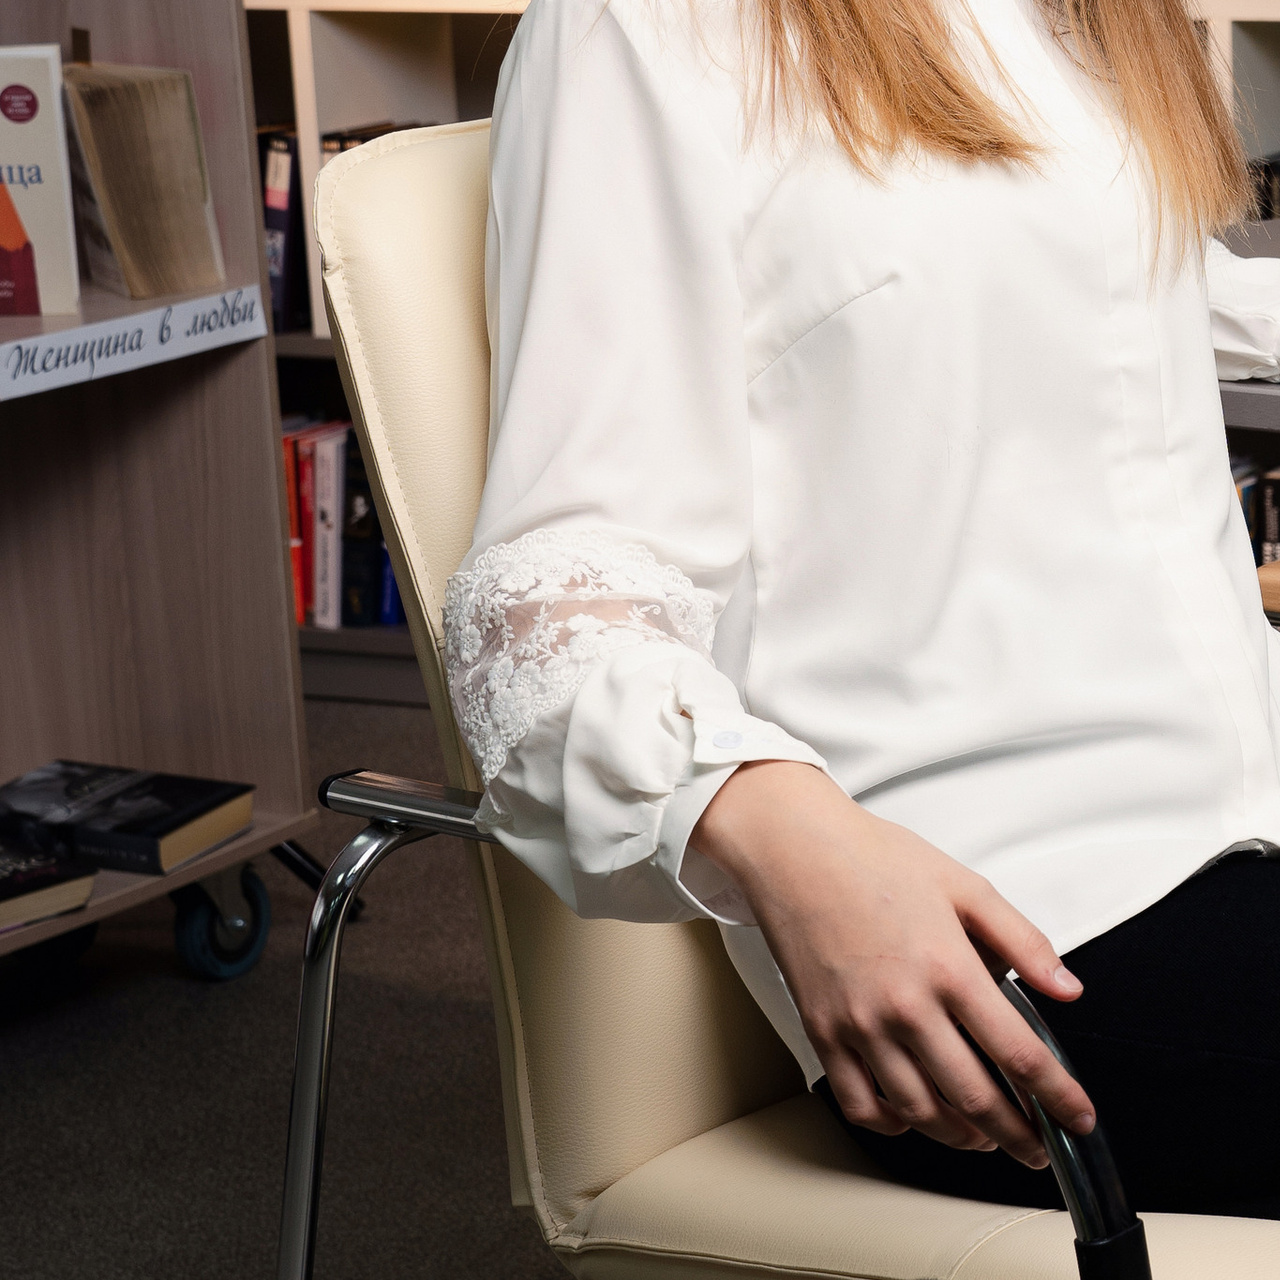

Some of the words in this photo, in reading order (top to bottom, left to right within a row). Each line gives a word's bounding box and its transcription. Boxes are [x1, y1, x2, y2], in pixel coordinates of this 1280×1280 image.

[0, 164, 43, 189] ца
[8, 328, 146, 380] Женщина
[158, 305, 174, 345] в
[185, 287, 257, 338] любви
